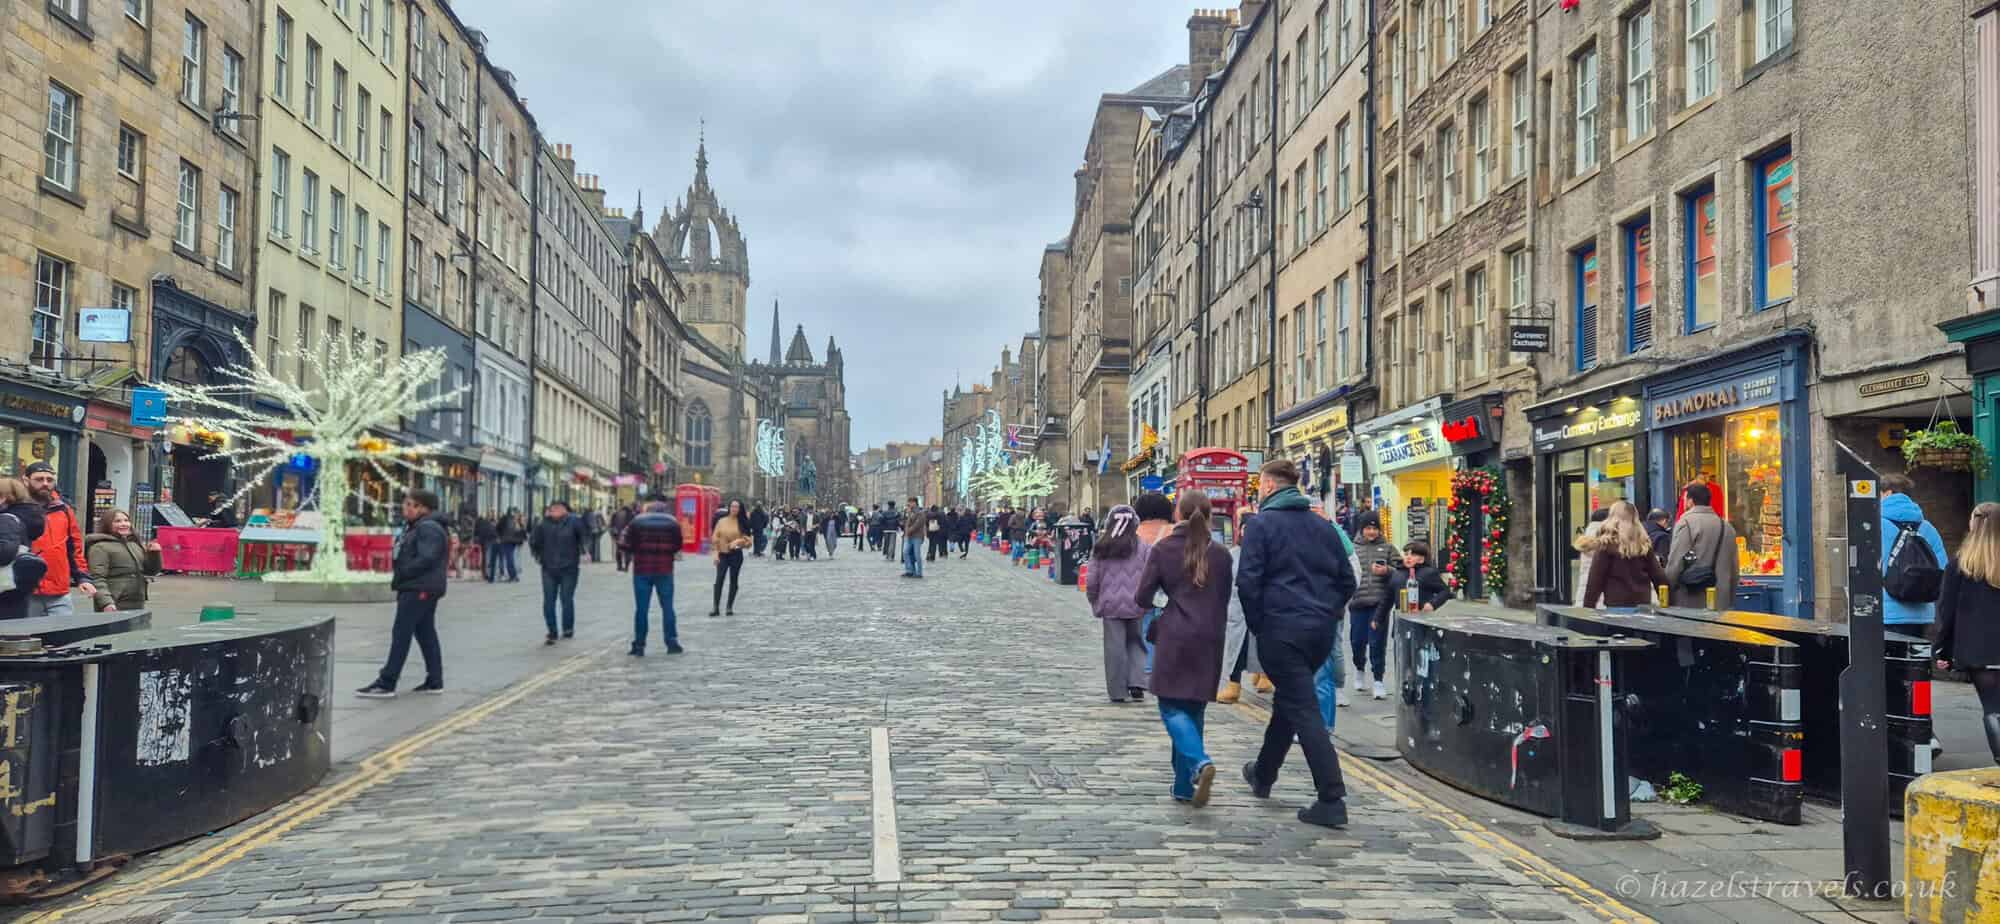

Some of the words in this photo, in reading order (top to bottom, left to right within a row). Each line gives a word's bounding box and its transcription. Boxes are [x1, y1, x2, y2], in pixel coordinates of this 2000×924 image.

[1512, 339, 1547, 348] Exchange
[1513, 331, 1547, 340] Currency
[1655, 384, 1738, 421] BALMORAL
[1562, 421, 1598, 439] Currency
[1599, 409, 1641, 432] Exchange
[1415, 438, 1439, 457] STORE
